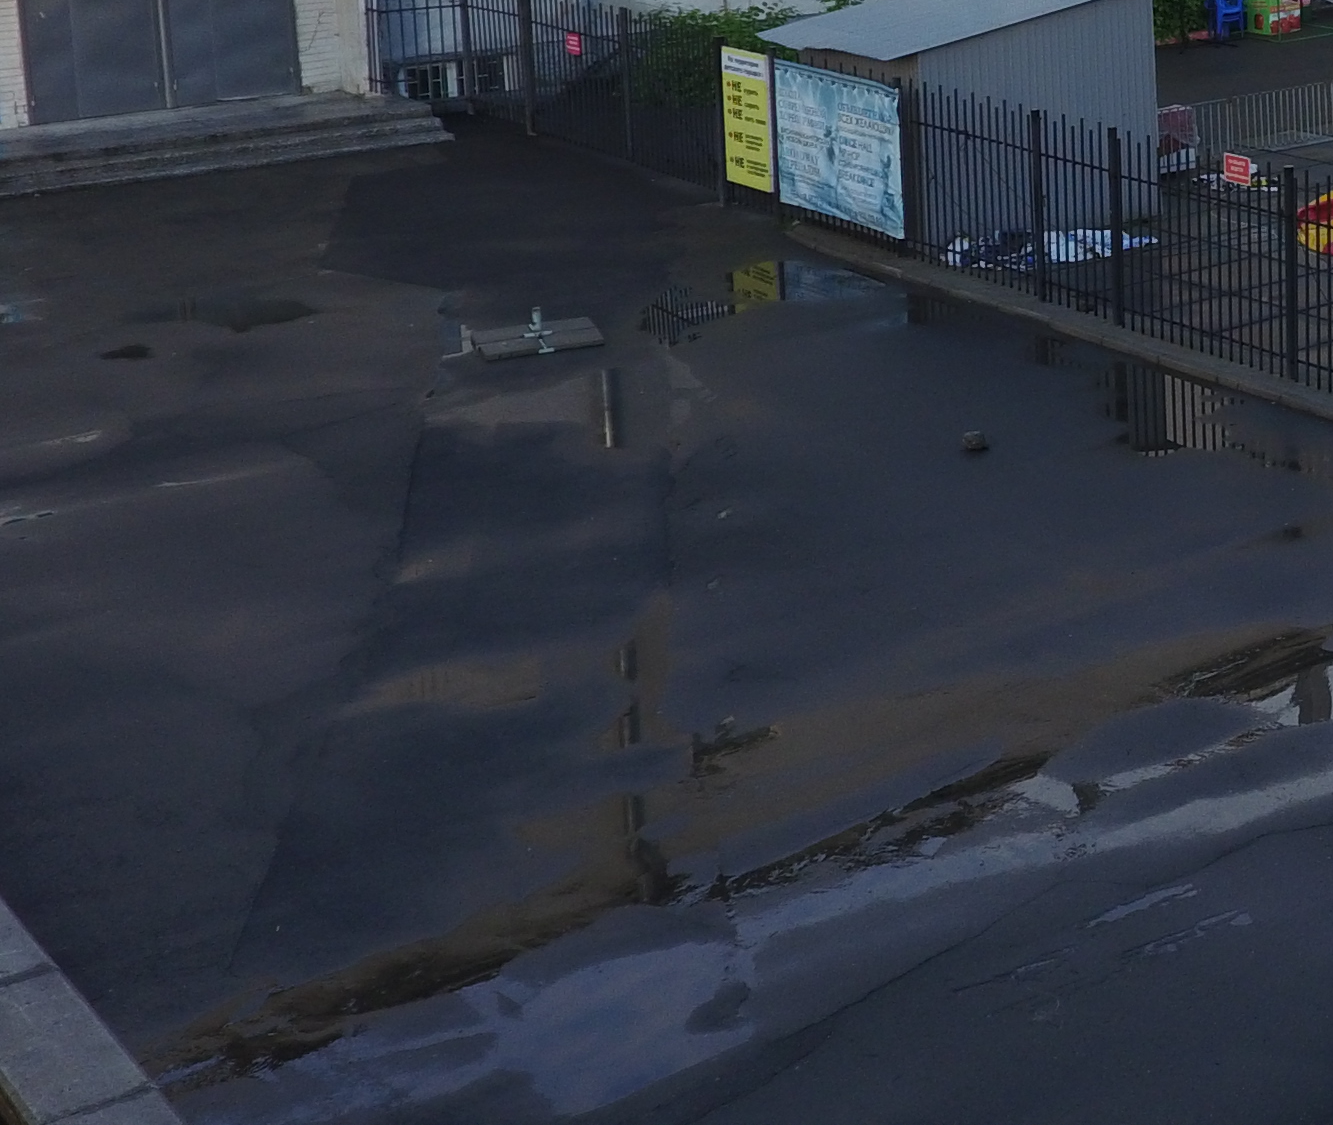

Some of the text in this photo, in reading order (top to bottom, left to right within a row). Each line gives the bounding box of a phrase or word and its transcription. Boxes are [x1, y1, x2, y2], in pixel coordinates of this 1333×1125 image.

[731, 80, 741, 92] НЕ
[732, 93, 742, 106] НЕ
[732, 107, 742, 120] НЕ
[734, 155, 744, 168] НЕ
